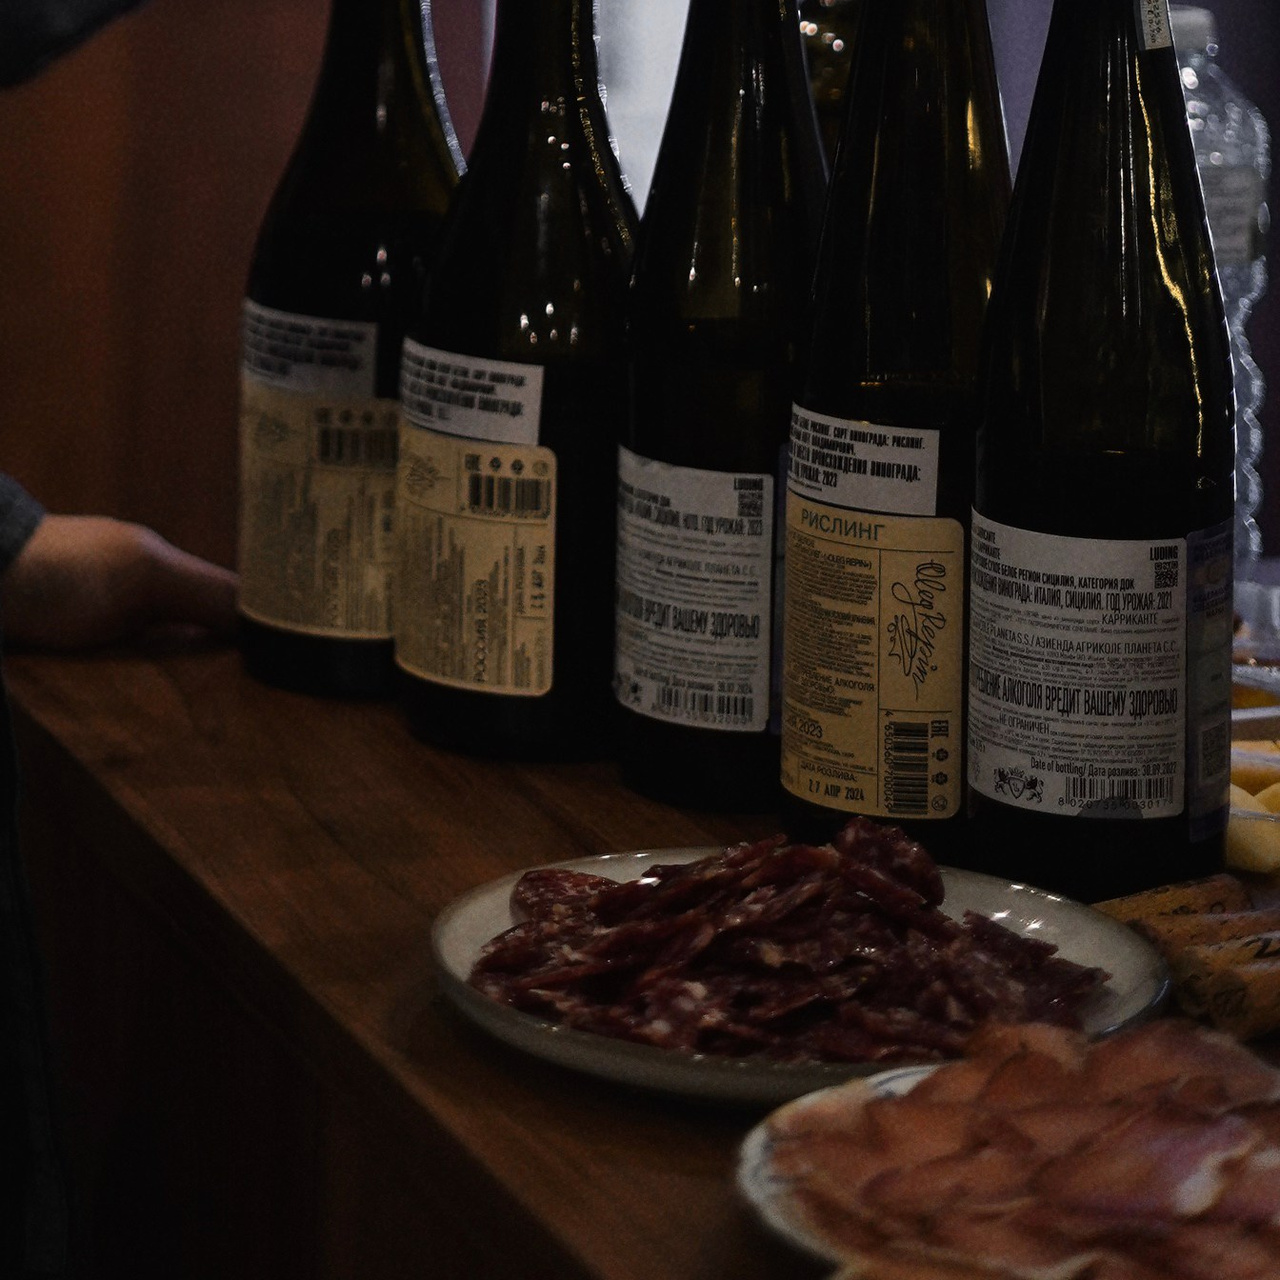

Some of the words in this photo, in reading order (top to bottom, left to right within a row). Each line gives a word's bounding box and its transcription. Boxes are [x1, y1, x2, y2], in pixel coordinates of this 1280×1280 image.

[850, 429, 890, 447] ВИНОГРАДА:
[811, 449, 868, 475] ПРОИСХОЖДЕНИЯ
[870, 460, 921, 482] ВИНОГРАДА:
[822, 470, 838, 488] 2023
[801, 508, 885, 541] РИСЛИНГ
[1150, 545, 1178, 562] LUDING
[1018, 568, 1041, 583] РЕГИОН
[1042, 573, 1076, 589] СИЦИЛИЯ,
[1078, 577, 1118, 591] КАТЕГОРИЯ
[1120, 578, 1135, 591] ДОК
[1034, 586, 1063, 610] ИТАЛИЯ,
[1106, 592, 1120, 613] ГОД
[1122, 593, 1156, 611] УРОЖАЯ:
[1157, 591, 1172, 610] 2021
[1102, 612, 1158, 625] КАРРИКАНТЕ
[1035, 637, 1073, 652] АЗИЕНДА
[1075, 641, 1121, 654] АГРИКОЛЕ
[1124, 641, 1162, 654] ПЛАНЕТА
[1002, 676, 1043, 709] АЛКОГОЛЯ
[1045, 685, 1082, 717] ВРЕДИТ
[1084, 690, 1127, 716] ВАШЕМУ
[1129, 688, 1178, 720] ЗДОРОВЬЮ
[799, 718, 823, 739] 2023
[1008, 716, 1049, 735] ОГРАНИЧЕН
[1031, 757, 1046, 769] Date
[1047, 760, 1055, 771] of
[1088, 764, 1106, 777] Дата
[1107, 766, 1138, 779] розлива:
